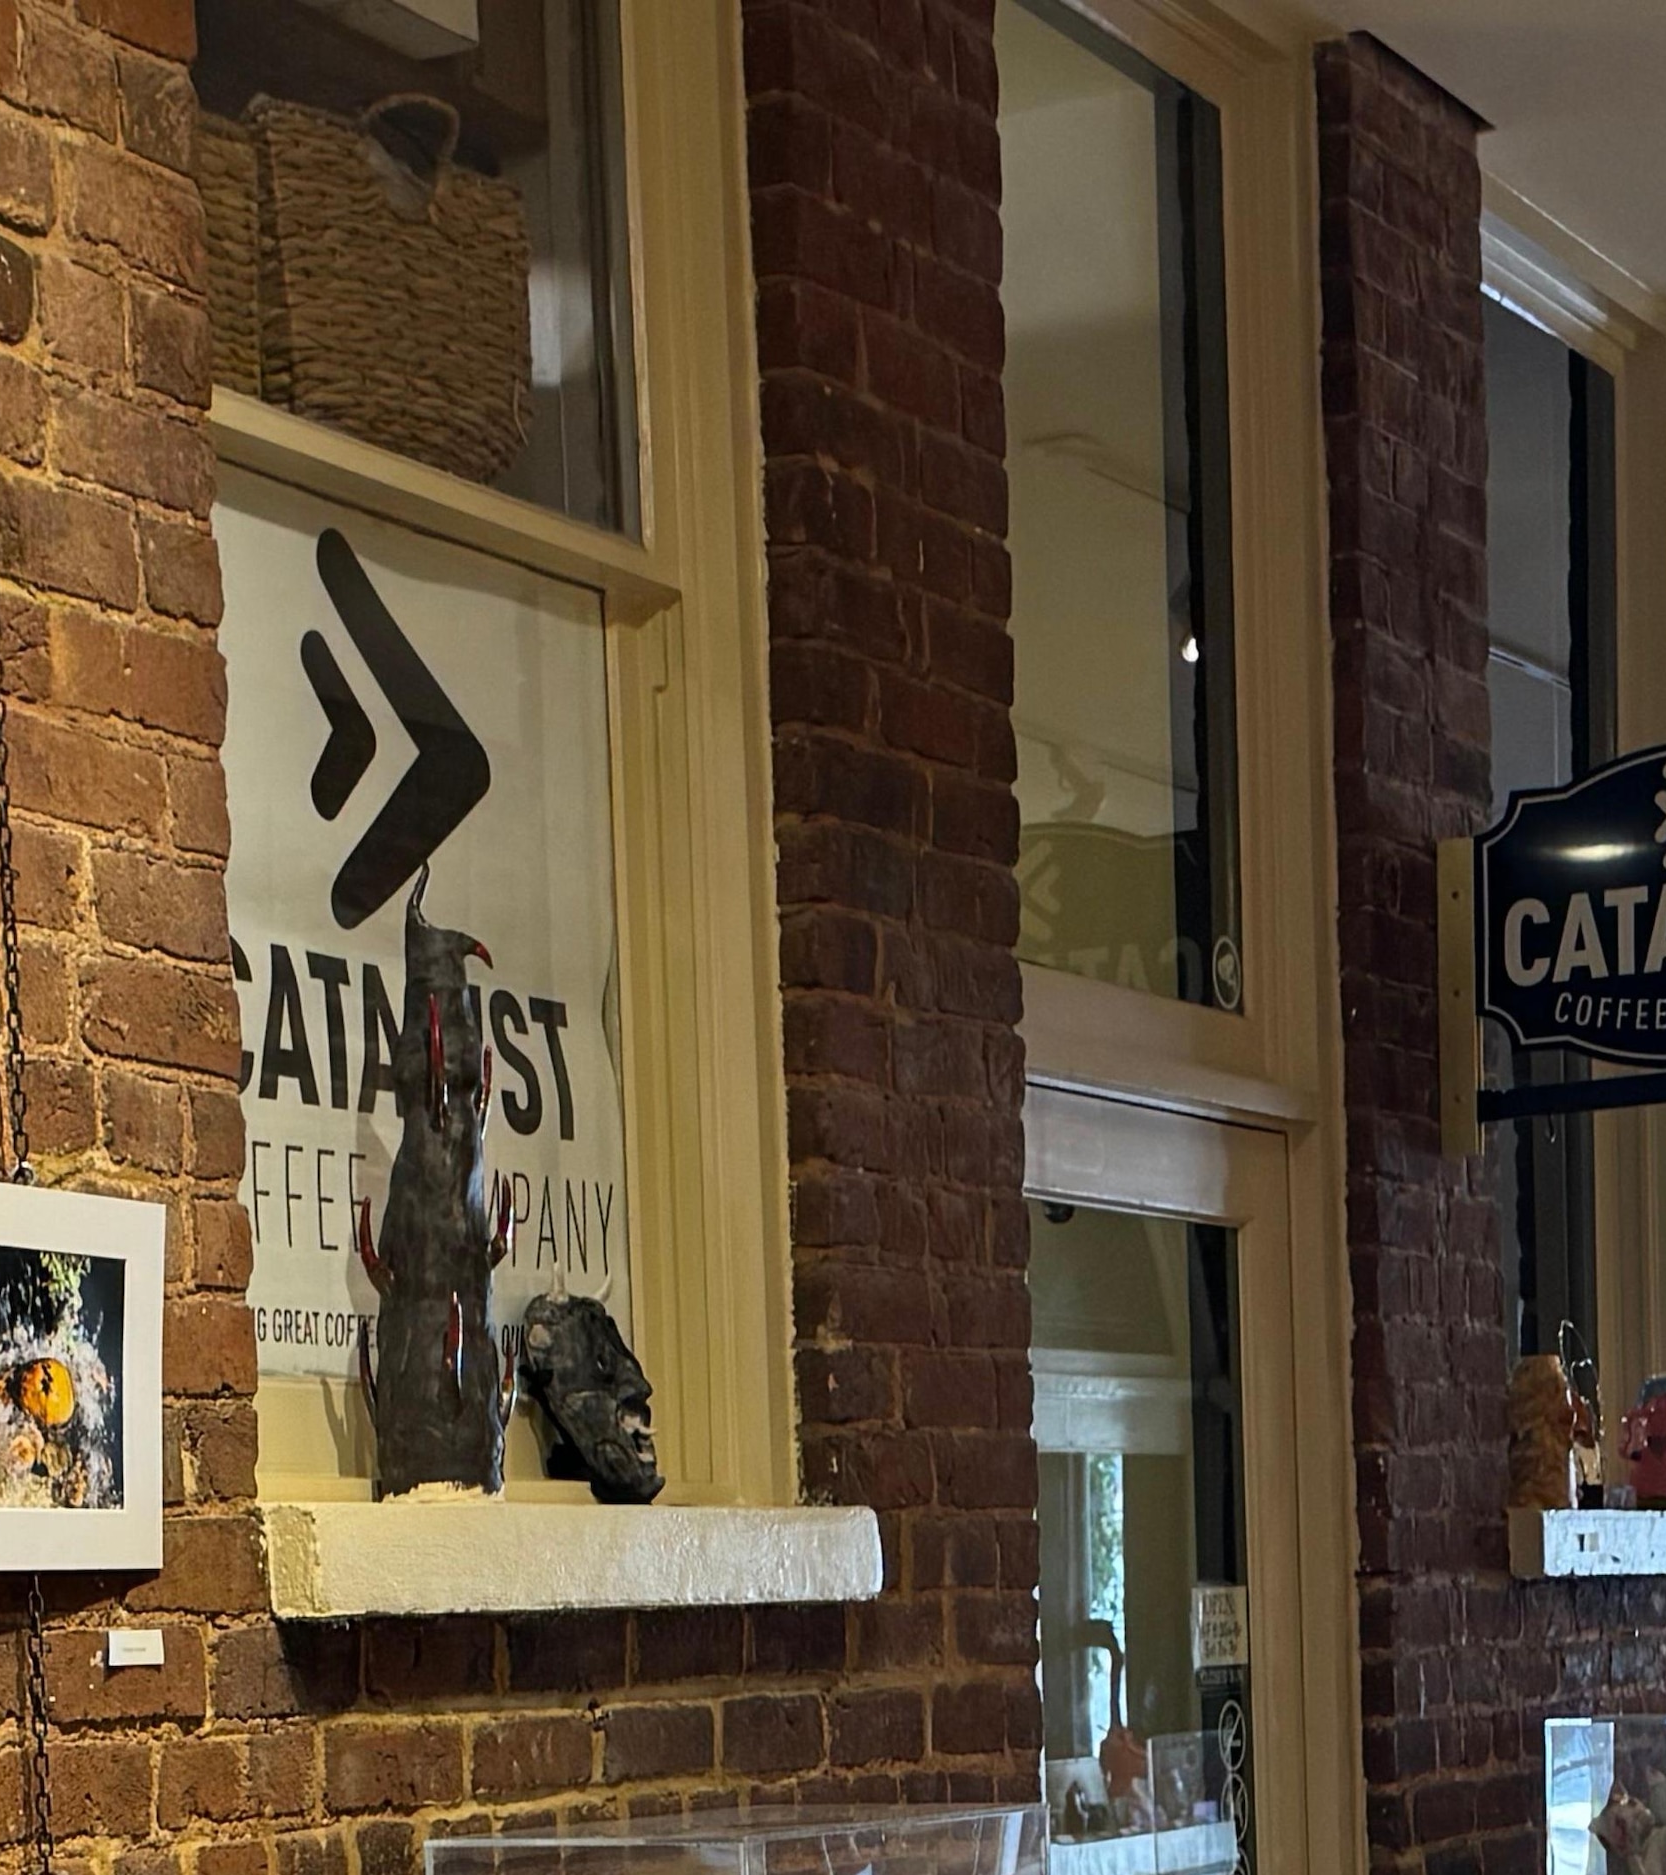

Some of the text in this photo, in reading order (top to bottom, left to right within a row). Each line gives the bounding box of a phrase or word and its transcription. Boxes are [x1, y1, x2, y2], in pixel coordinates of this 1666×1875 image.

[230, 935, 575, 1141] ATAST
[252, 1140, 367, 1253] FFEE
[272, 1307, 320, 1346] GREAT
[324, 1312, 377, 1348] COFFE
